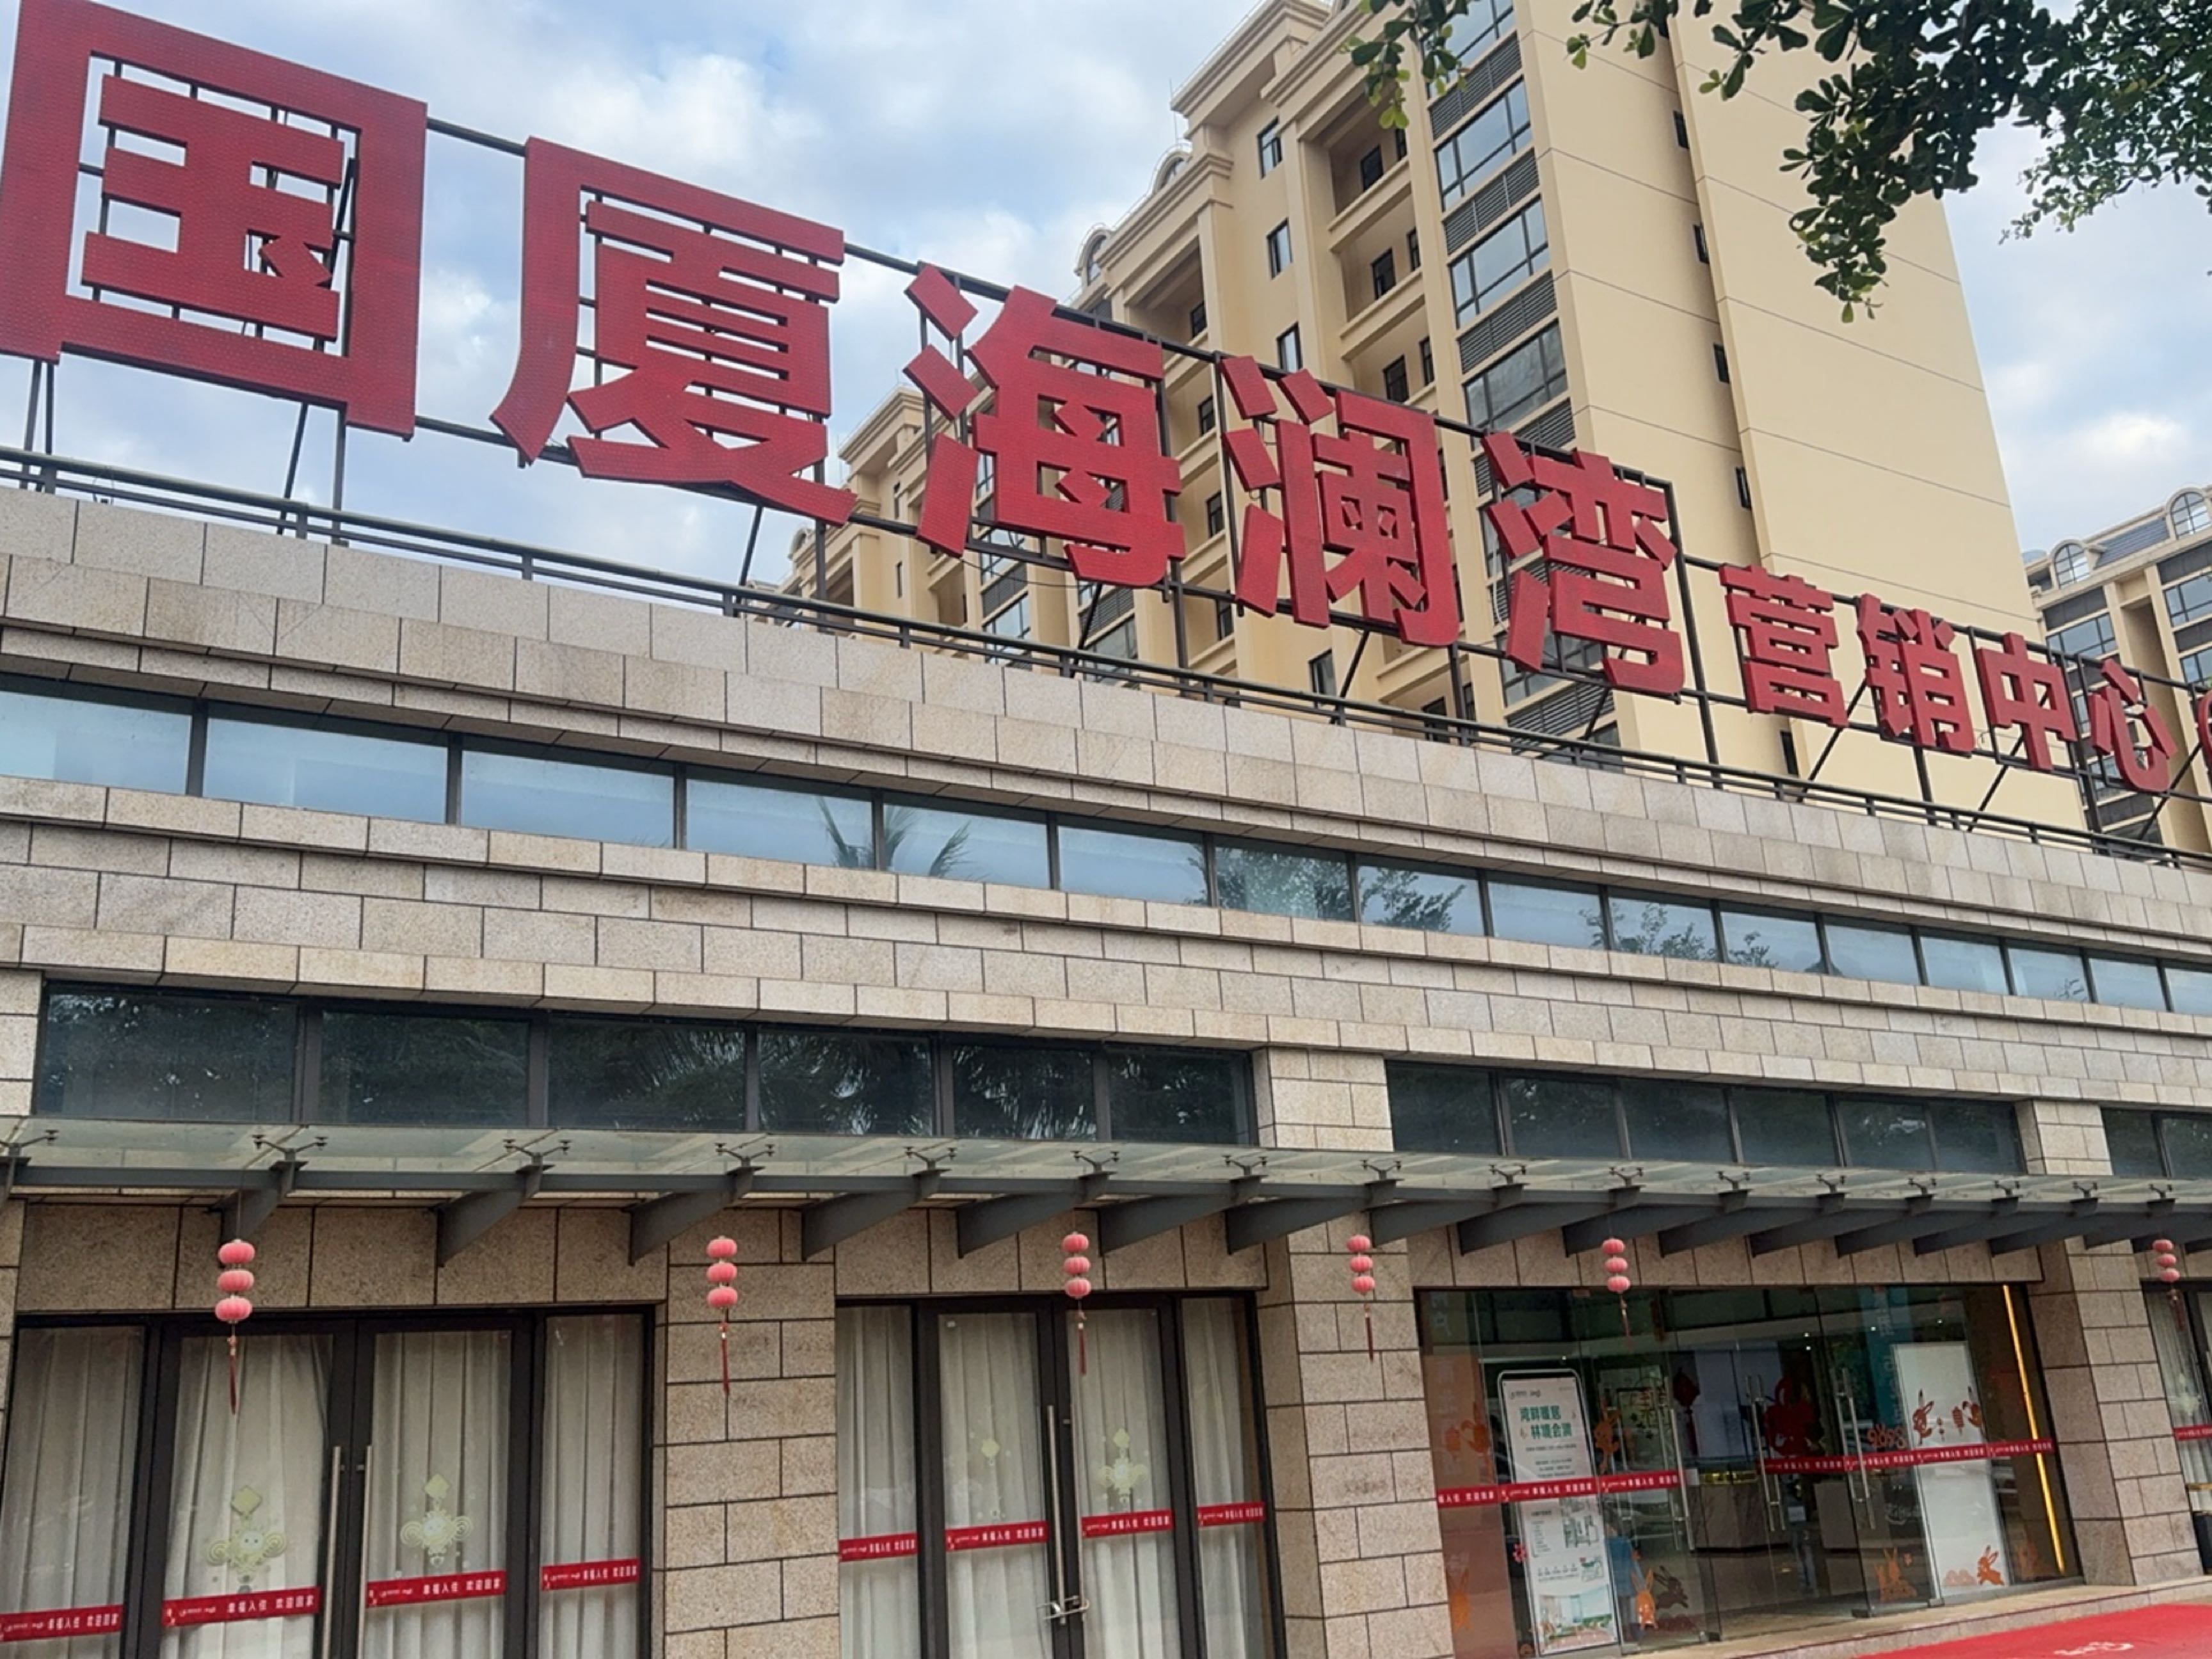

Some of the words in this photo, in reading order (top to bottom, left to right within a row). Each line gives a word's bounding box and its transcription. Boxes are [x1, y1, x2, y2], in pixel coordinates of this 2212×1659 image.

[0, 0, 1685, 696] 国厦海澜湾
[1719, 564, 2177, 793] 营销中心
